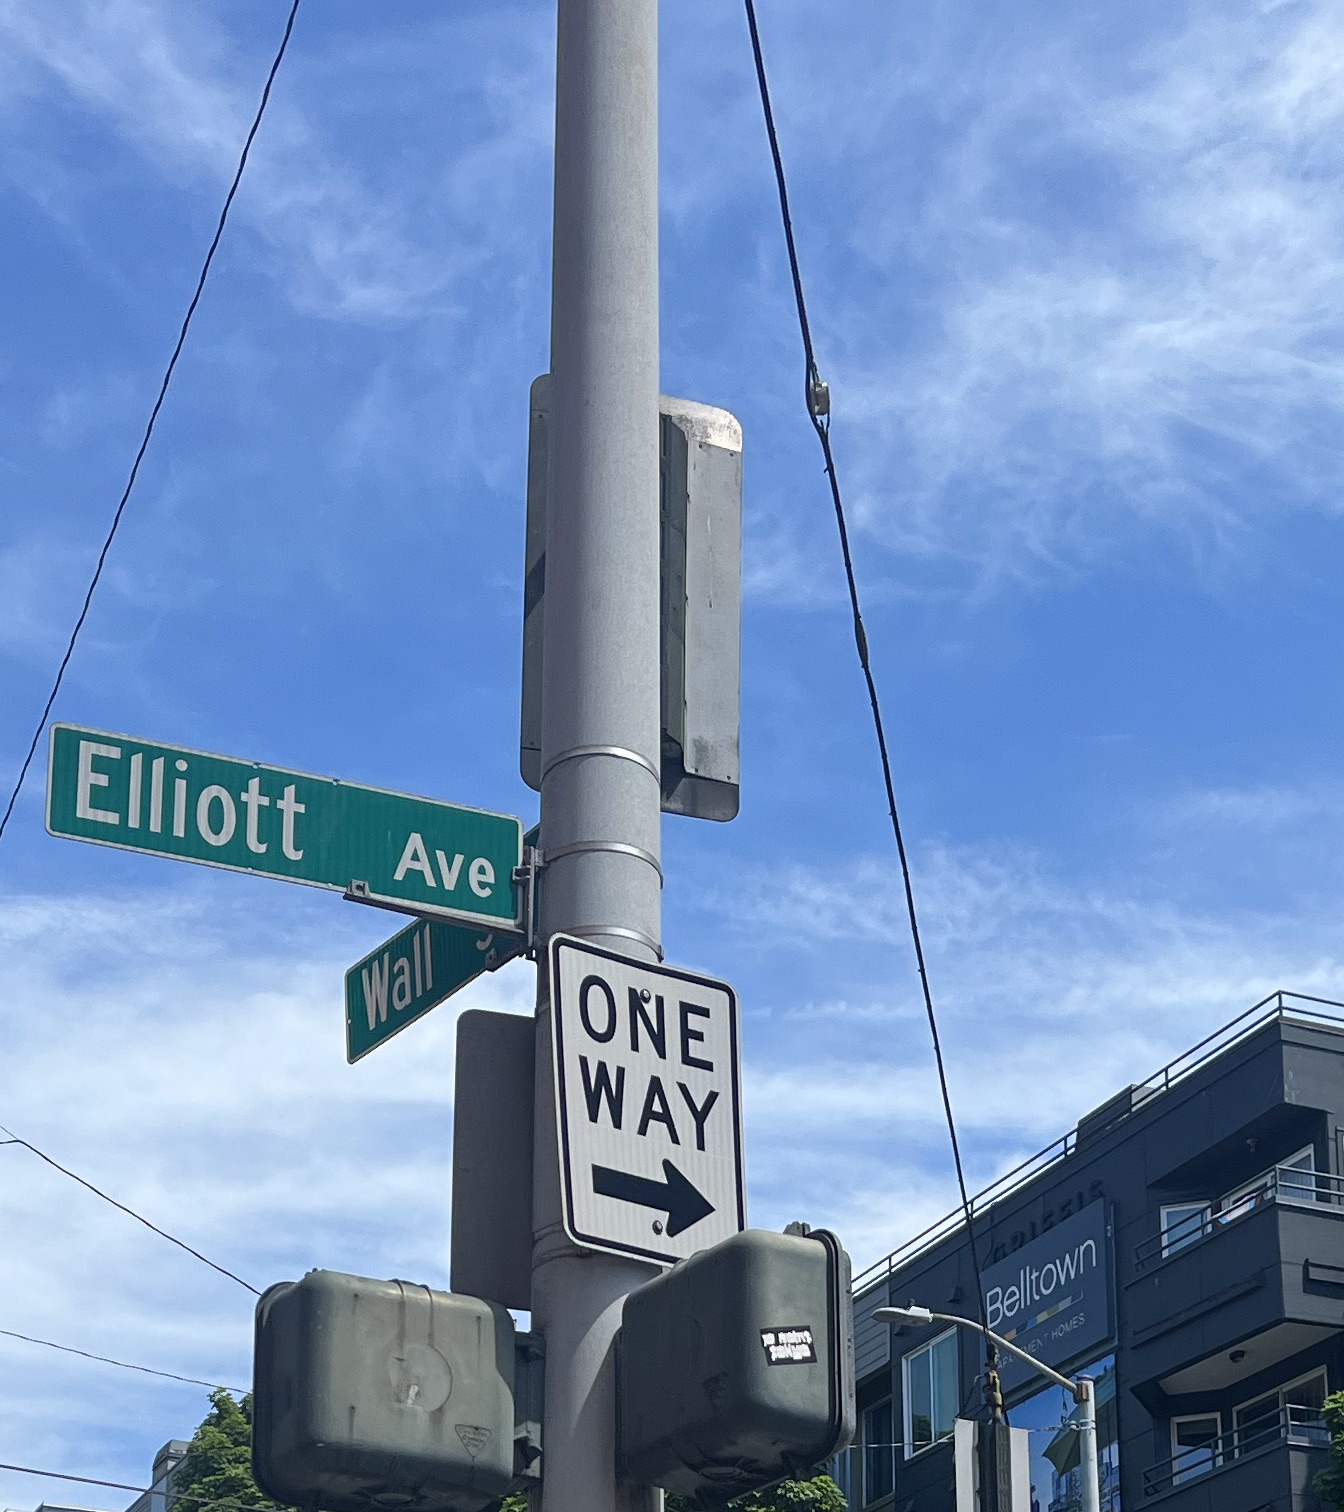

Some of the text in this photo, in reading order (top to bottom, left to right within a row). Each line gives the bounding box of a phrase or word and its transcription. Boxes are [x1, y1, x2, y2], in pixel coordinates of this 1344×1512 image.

[75, 739, 497, 899] Elliott Ave
[361, 922, 434, 1031] Wall
[577, 973, 715, 1073] ONE
[577, 1053, 721, 1152] WAY
[986, 1239, 1097, 1330] Belltown
[997, 1312, 1086, 1370] APAMENT HOMES
